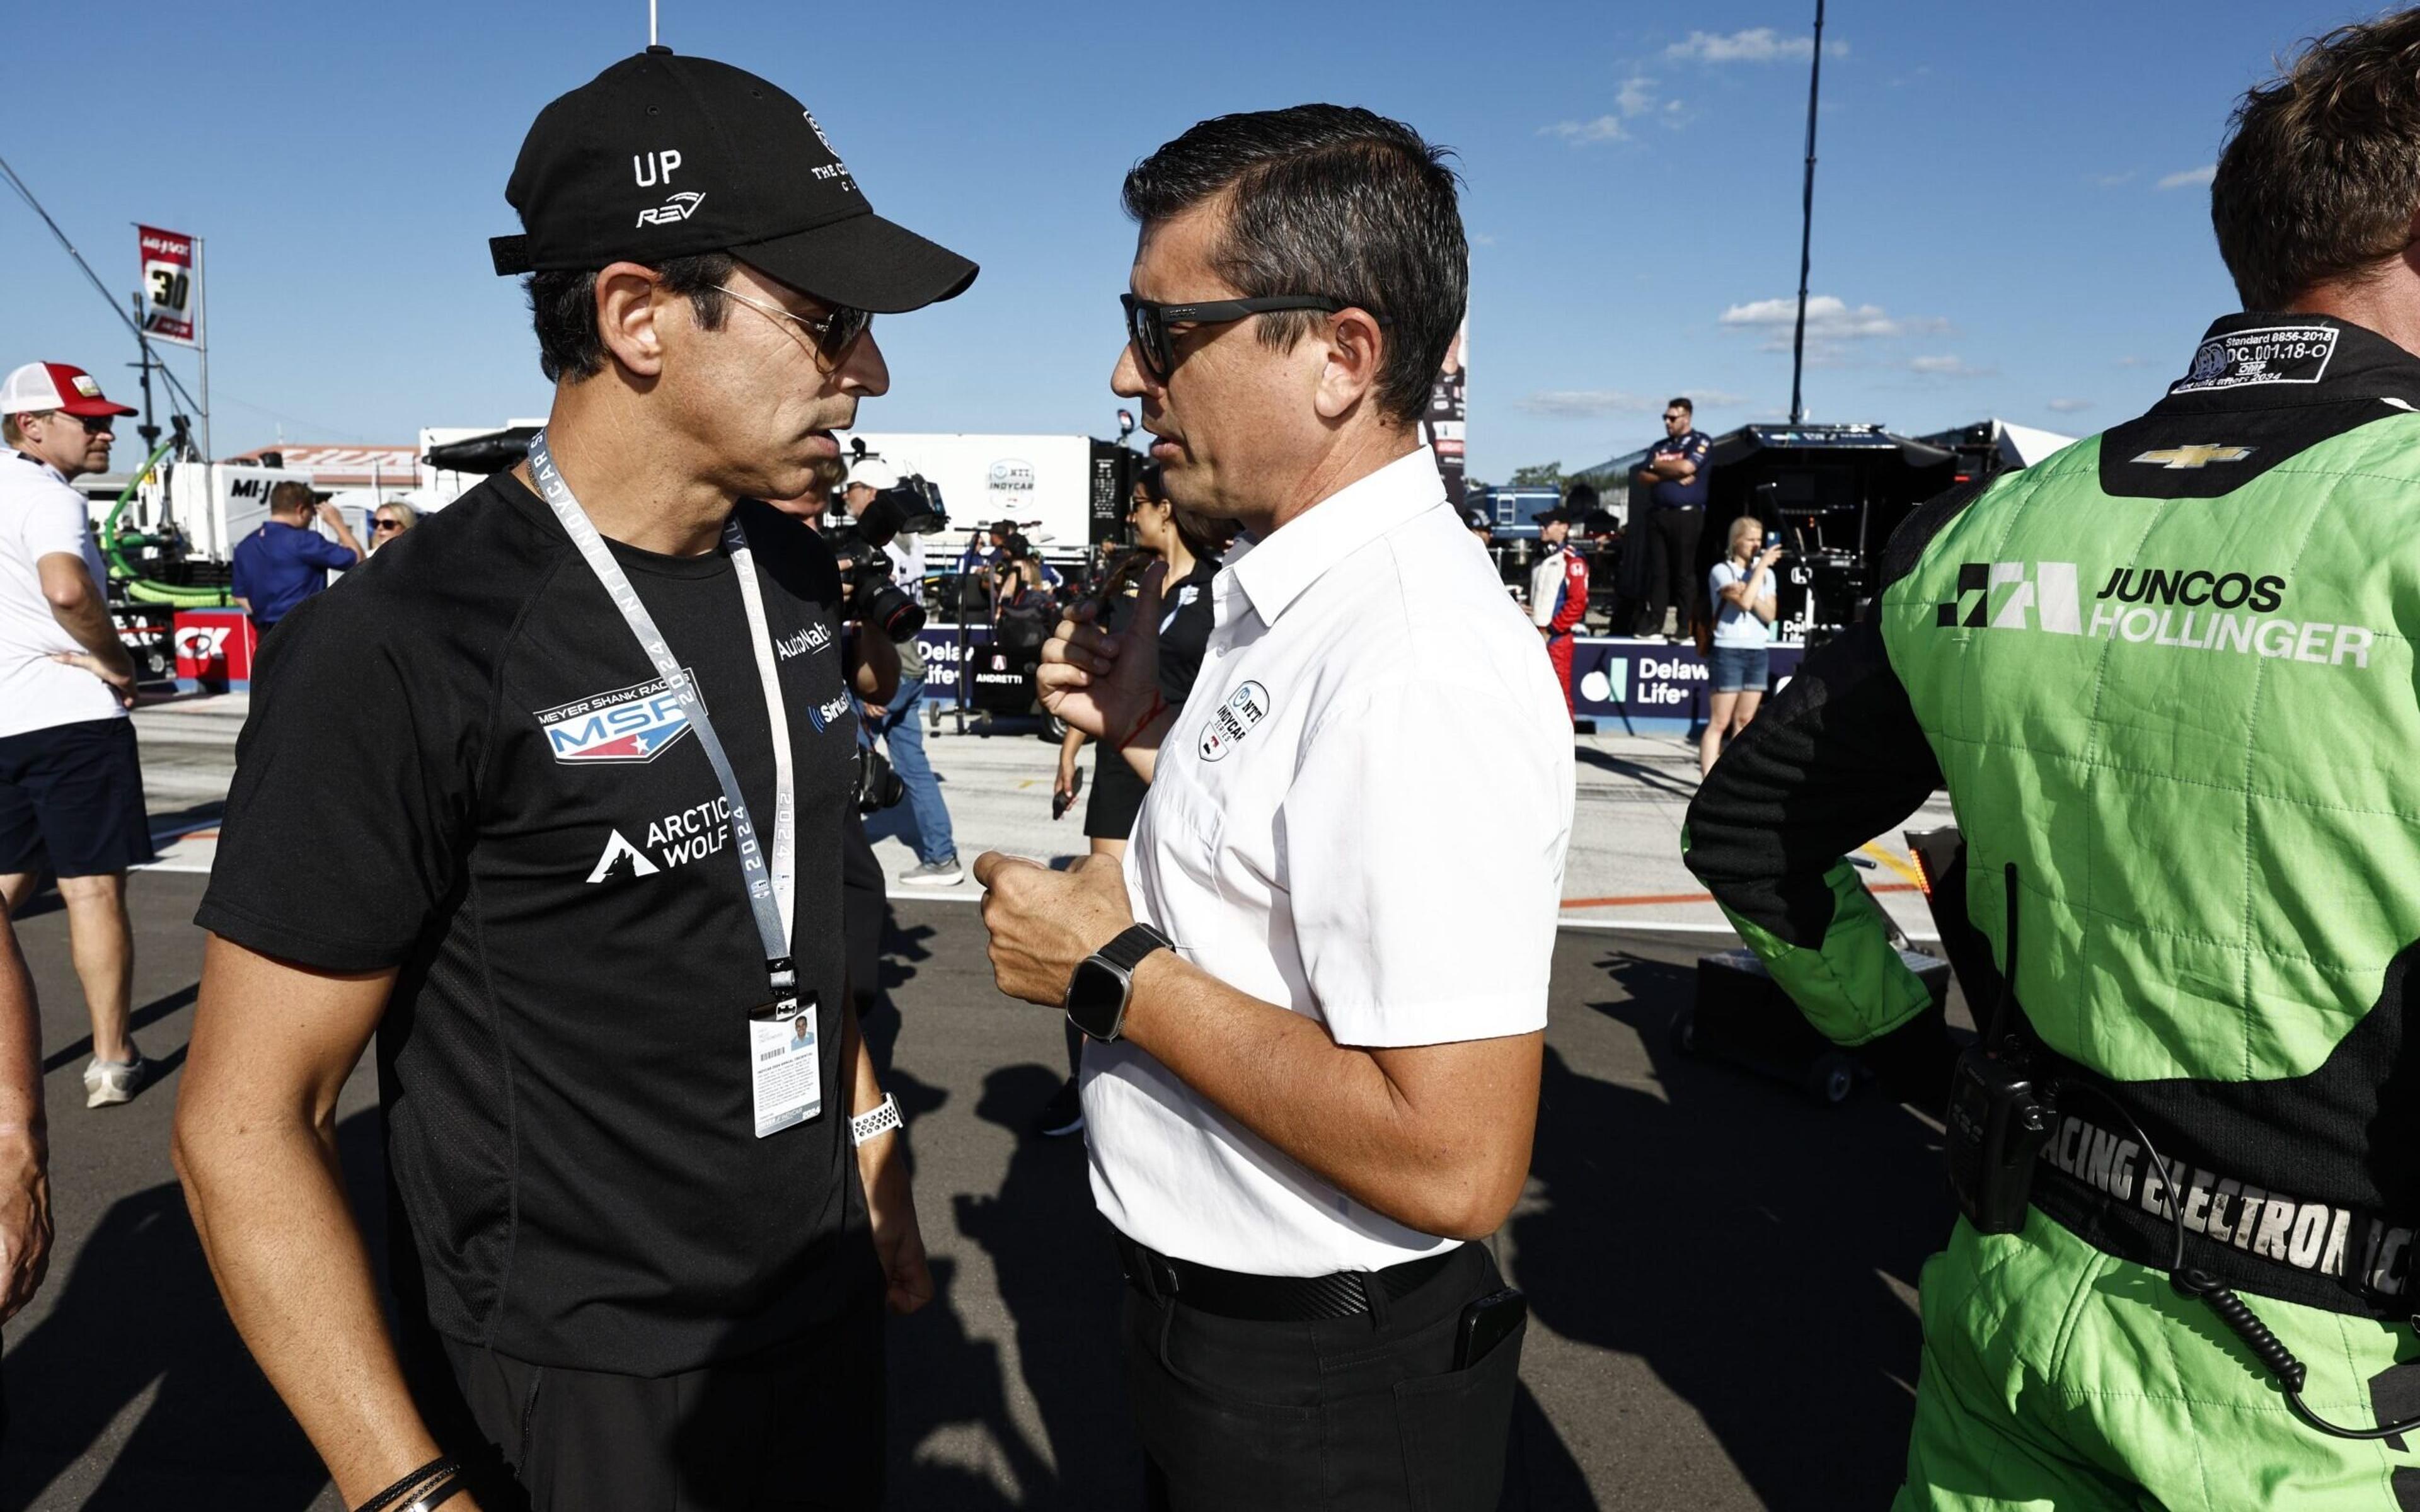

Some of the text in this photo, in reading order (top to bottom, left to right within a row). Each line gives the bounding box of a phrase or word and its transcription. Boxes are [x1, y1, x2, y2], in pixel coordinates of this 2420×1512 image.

[634, 150, 681, 187] UP
[811, 164, 837, 180] THE
[636, 192, 706, 228] REV
[153, 270, 188, 310] 30
[2226, 331, 2332, 346] Standard 8856-2018
[990, 482, 1034, 490] INDYCAR
[2097, 568, 2286, 613] JUNCOS
[2088, 605, 2375, 668] HOLLINGER
[649, 641, 694, 706] 2024
[976, 673, 1022, 684] ANDRETTI
[538, 702, 591, 725] MEYER
[591, 690, 638, 709] SHANK
[1242, 699, 1263, 723] NTT
[1637, 682, 1681, 704] Life
[1214, 719, 1231, 742] SERIES
[1217, 704, 1246, 743] INDYCAR
[647, 796, 730, 849] ARCTIC
[733, 805, 762, 871] 2024
[776, 793, 792, 858] 2024
[662, 825, 728, 868] WOLF
